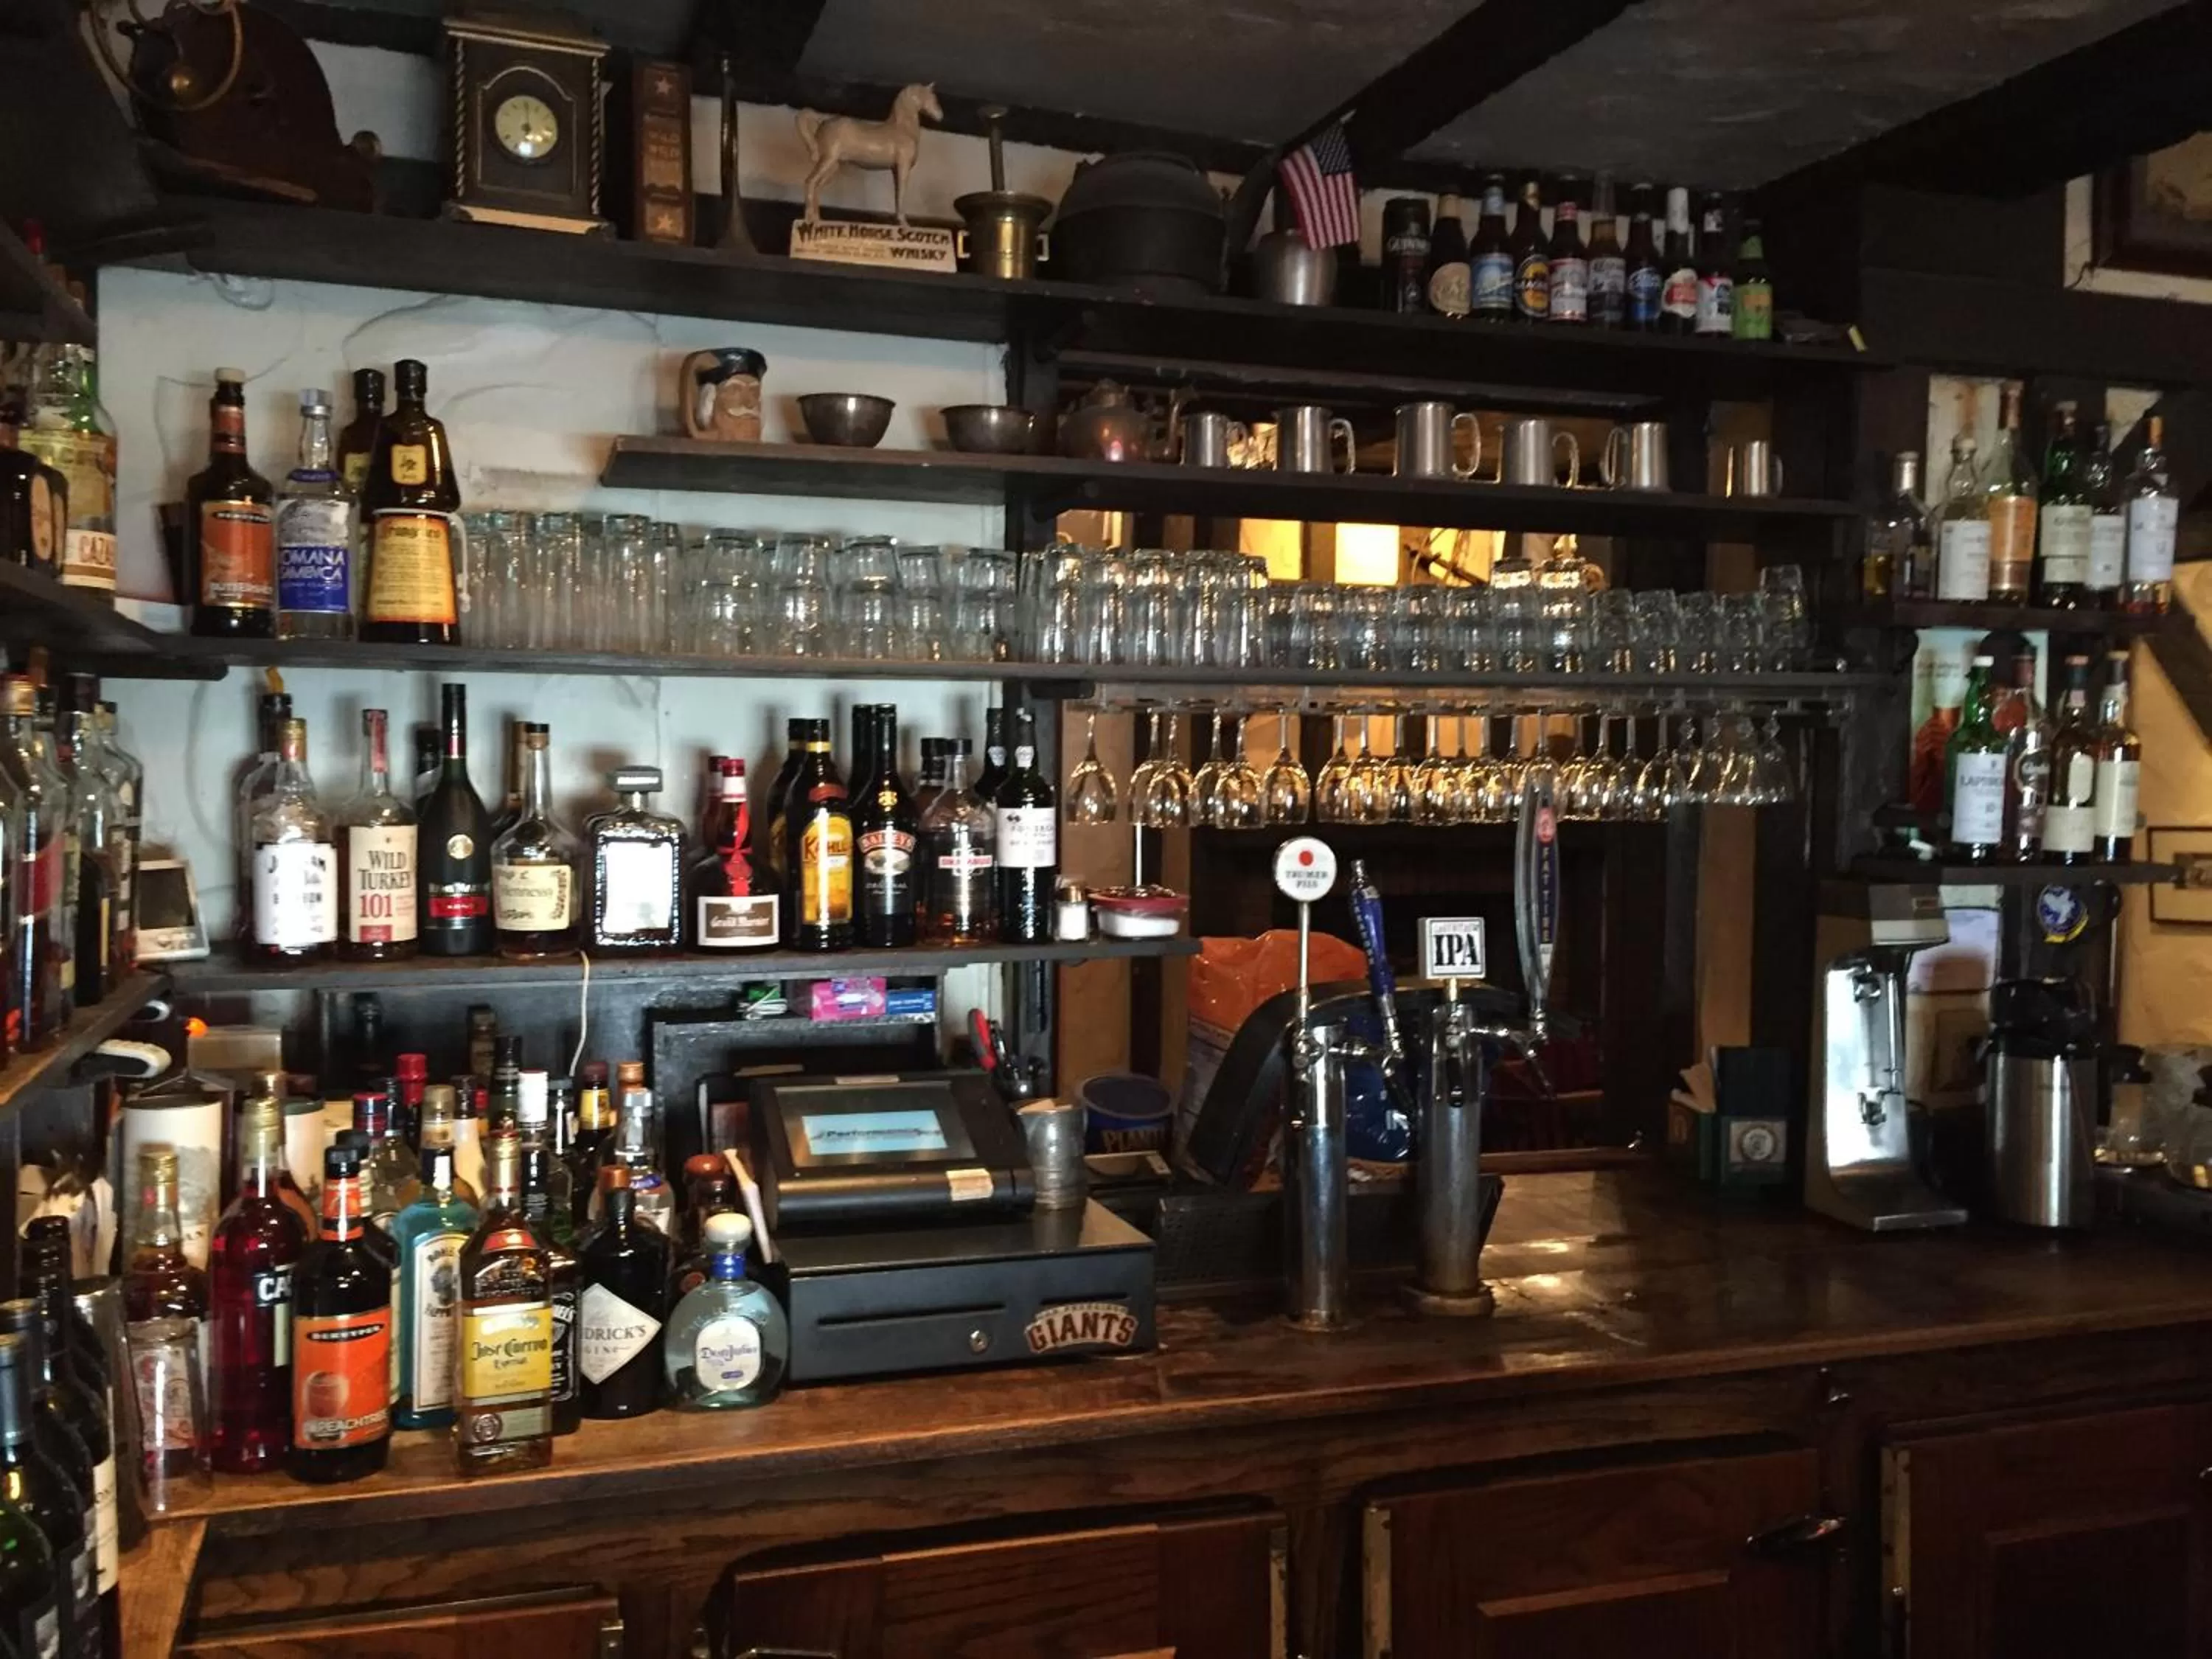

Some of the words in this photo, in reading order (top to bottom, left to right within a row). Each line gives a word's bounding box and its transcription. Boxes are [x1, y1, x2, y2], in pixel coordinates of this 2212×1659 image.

[897, 227, 950, 246] SCOTCH
[890, 246, 947, 261] WHISKY
[282, 549, 346, 566] OMANA
[368, 851, 407, 869] WILD
[358, 894, 393, 918] 101
[1433, 933, 1481, 967] IPA
[581, 1324, 647, 1340] DRICK'S
[1026, 1311, 1136, 1352] GIANTS
